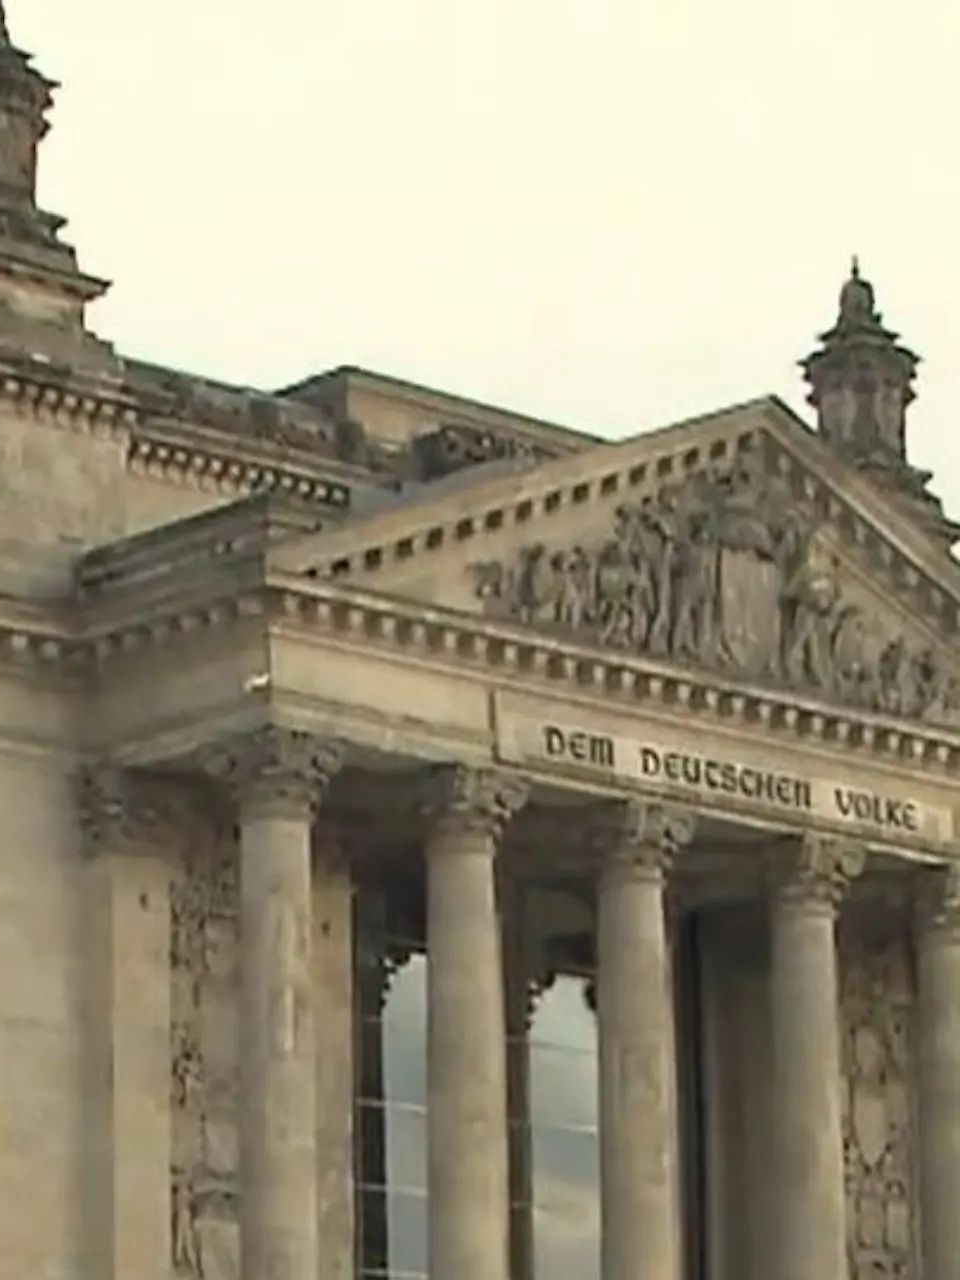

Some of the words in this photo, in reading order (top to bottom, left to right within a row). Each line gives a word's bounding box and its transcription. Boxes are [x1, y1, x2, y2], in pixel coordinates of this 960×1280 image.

[544, 726, 614, 767] DEM
[641, 747, 812, 808] DEUTSCHEN
[834, 788, 918, 831] VOLKE
